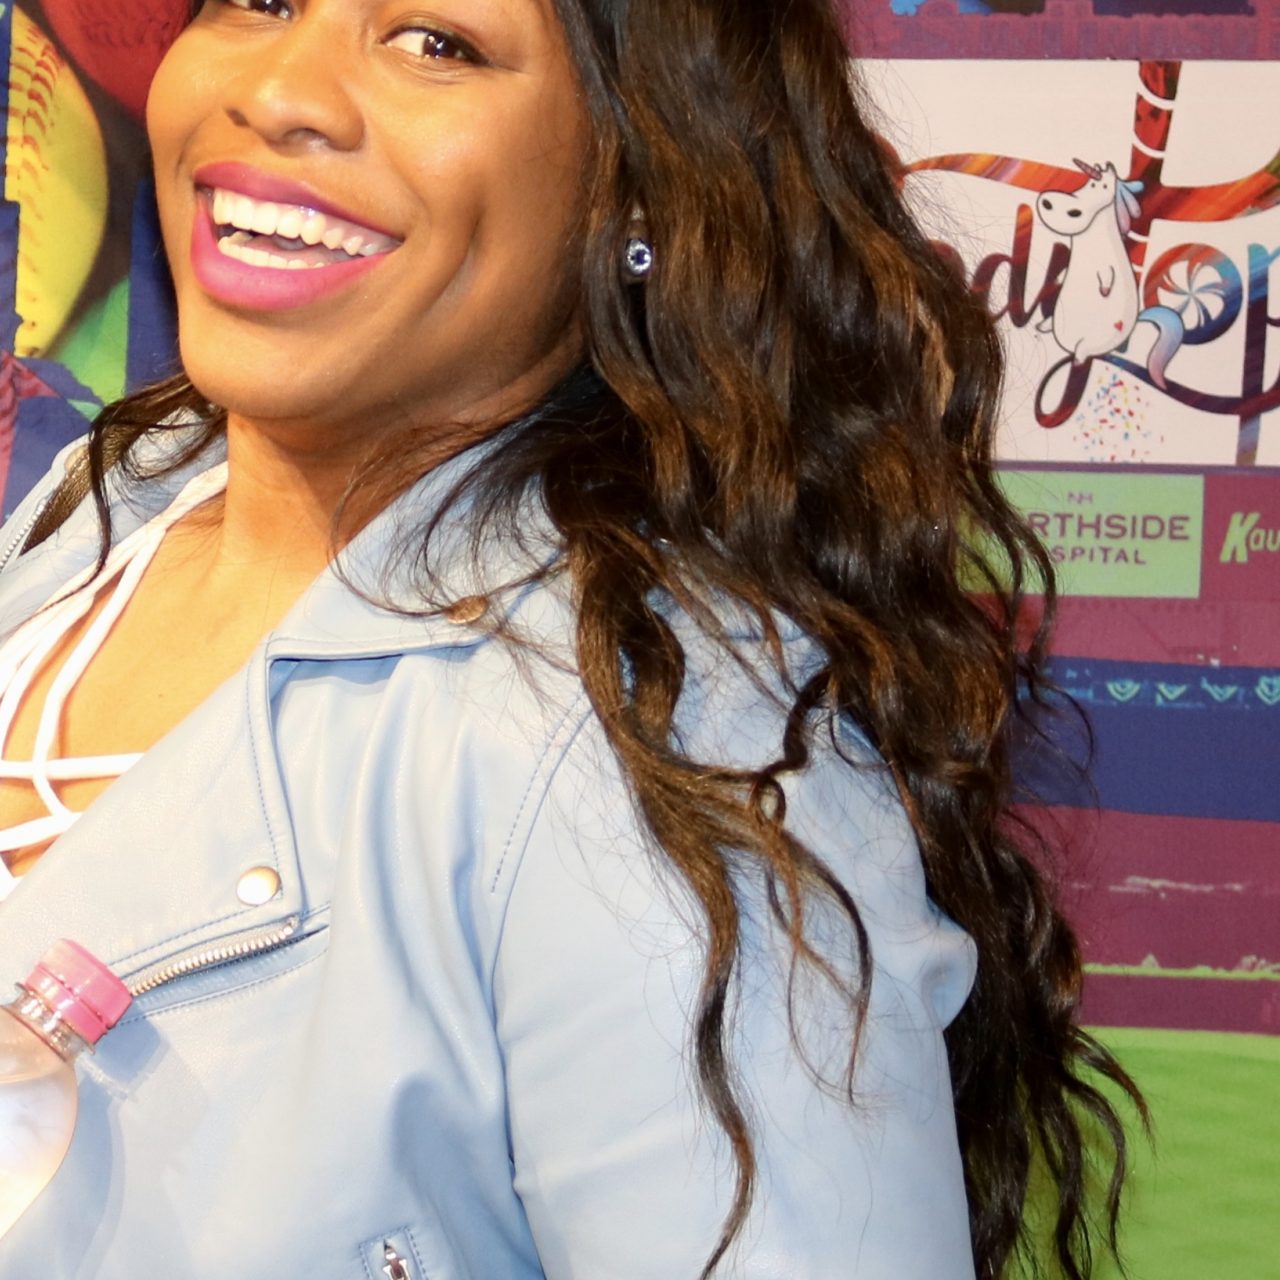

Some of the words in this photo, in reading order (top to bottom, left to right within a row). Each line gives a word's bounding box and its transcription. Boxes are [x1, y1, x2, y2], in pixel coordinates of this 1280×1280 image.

[1027, 512, 1191, 541] RTHSIDE
[1219, 511, 1280, 564] Kau
[1051, 545, 1147, 566] SPITAL
